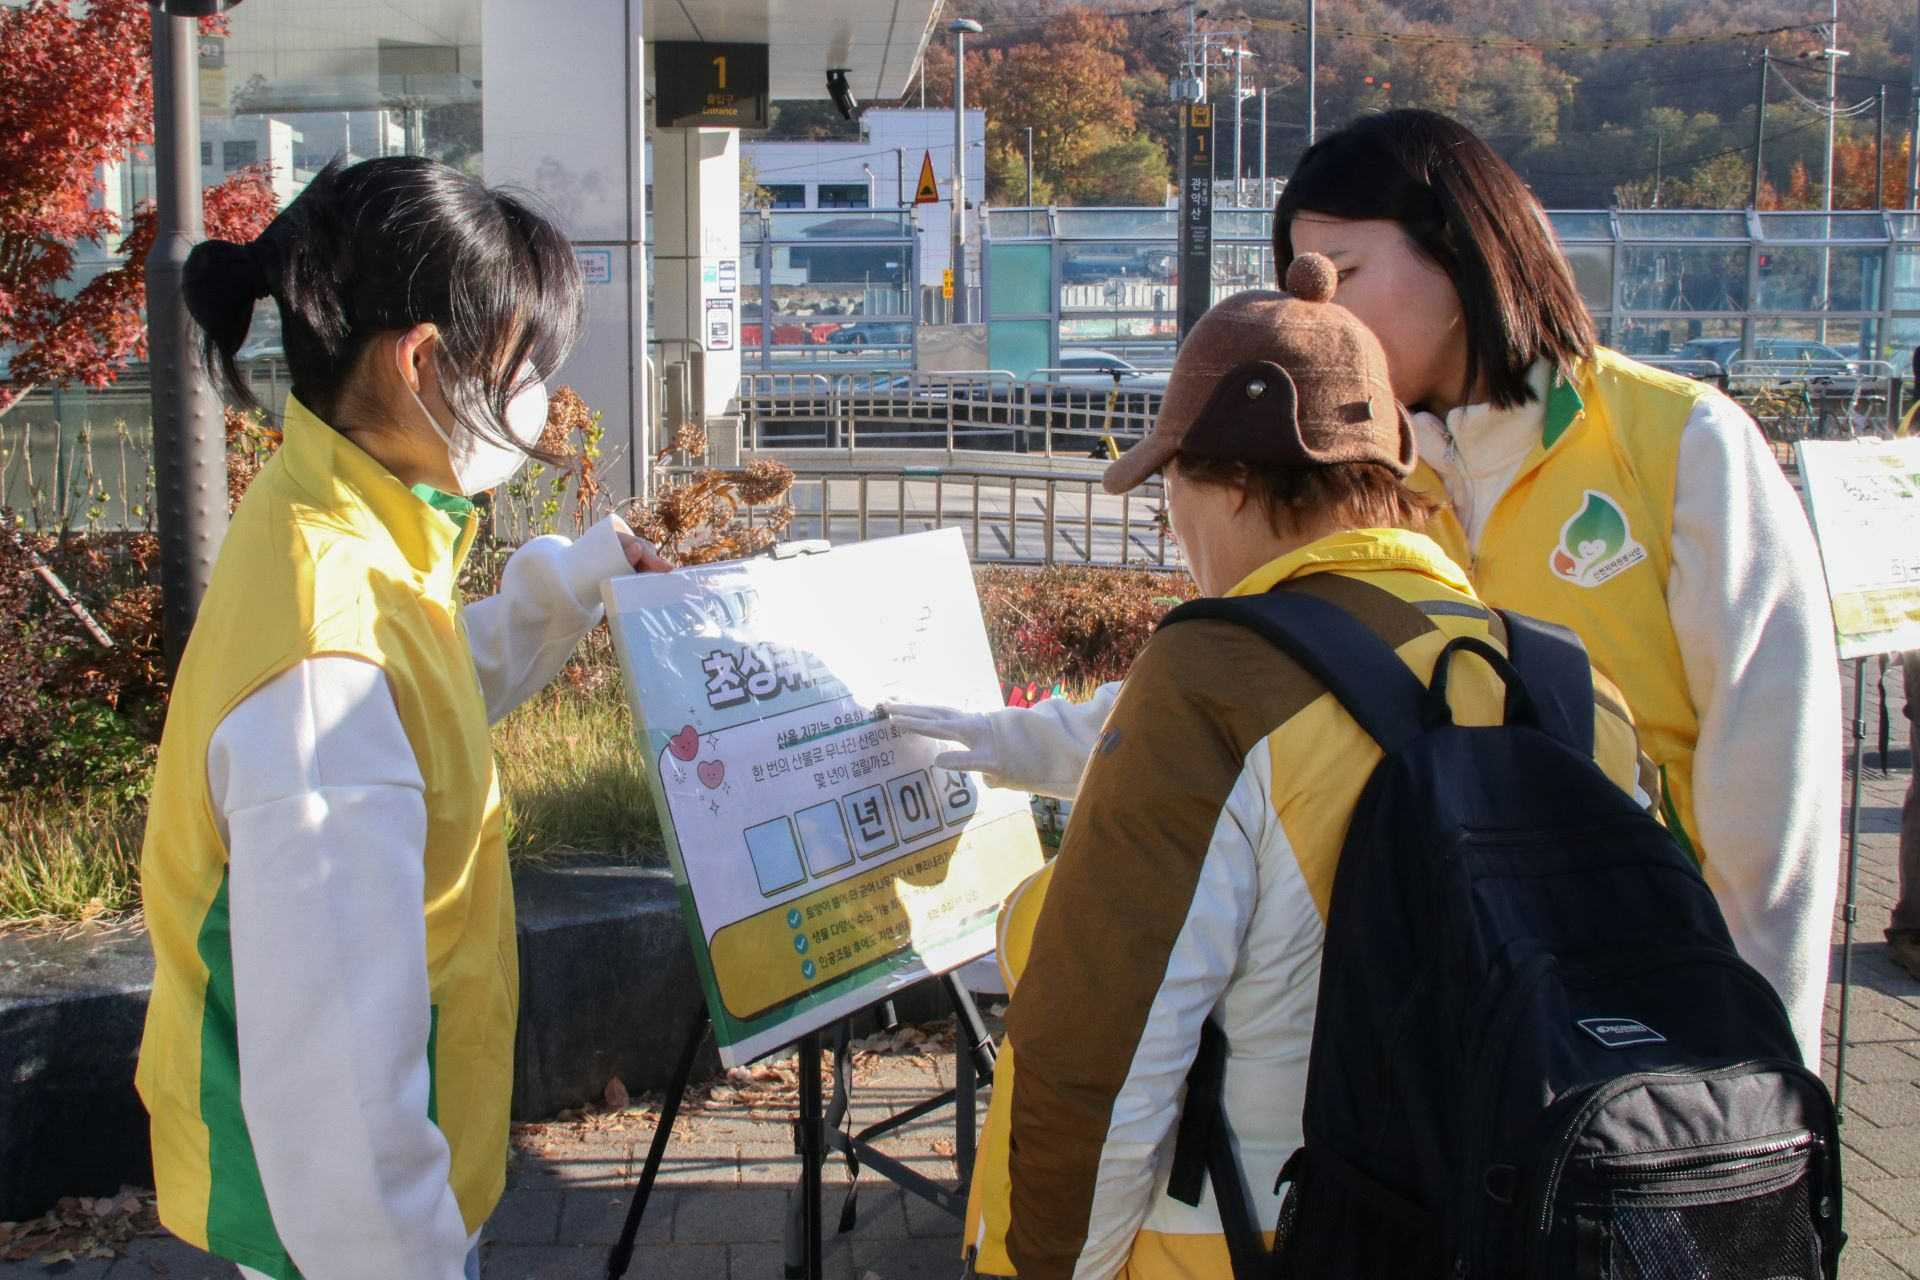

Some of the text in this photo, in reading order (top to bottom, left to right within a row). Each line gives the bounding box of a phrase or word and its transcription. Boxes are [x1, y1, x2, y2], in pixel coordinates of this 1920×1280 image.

[712, 56, 726, 89] 1
[1197, 135, 1205, 152] 1
[1190, 177, 1202, 220] 관악산
[752, 763, 766, 782] 한
[766, 758, 791, 779] 번의
[791, 747, 824, 771] 산불로
[825, 740, 857, 760] 무너진
[858, 727, 889, 748] 산림이
[813, 750, 896, 790] 몇 년이 걸릴까요?
